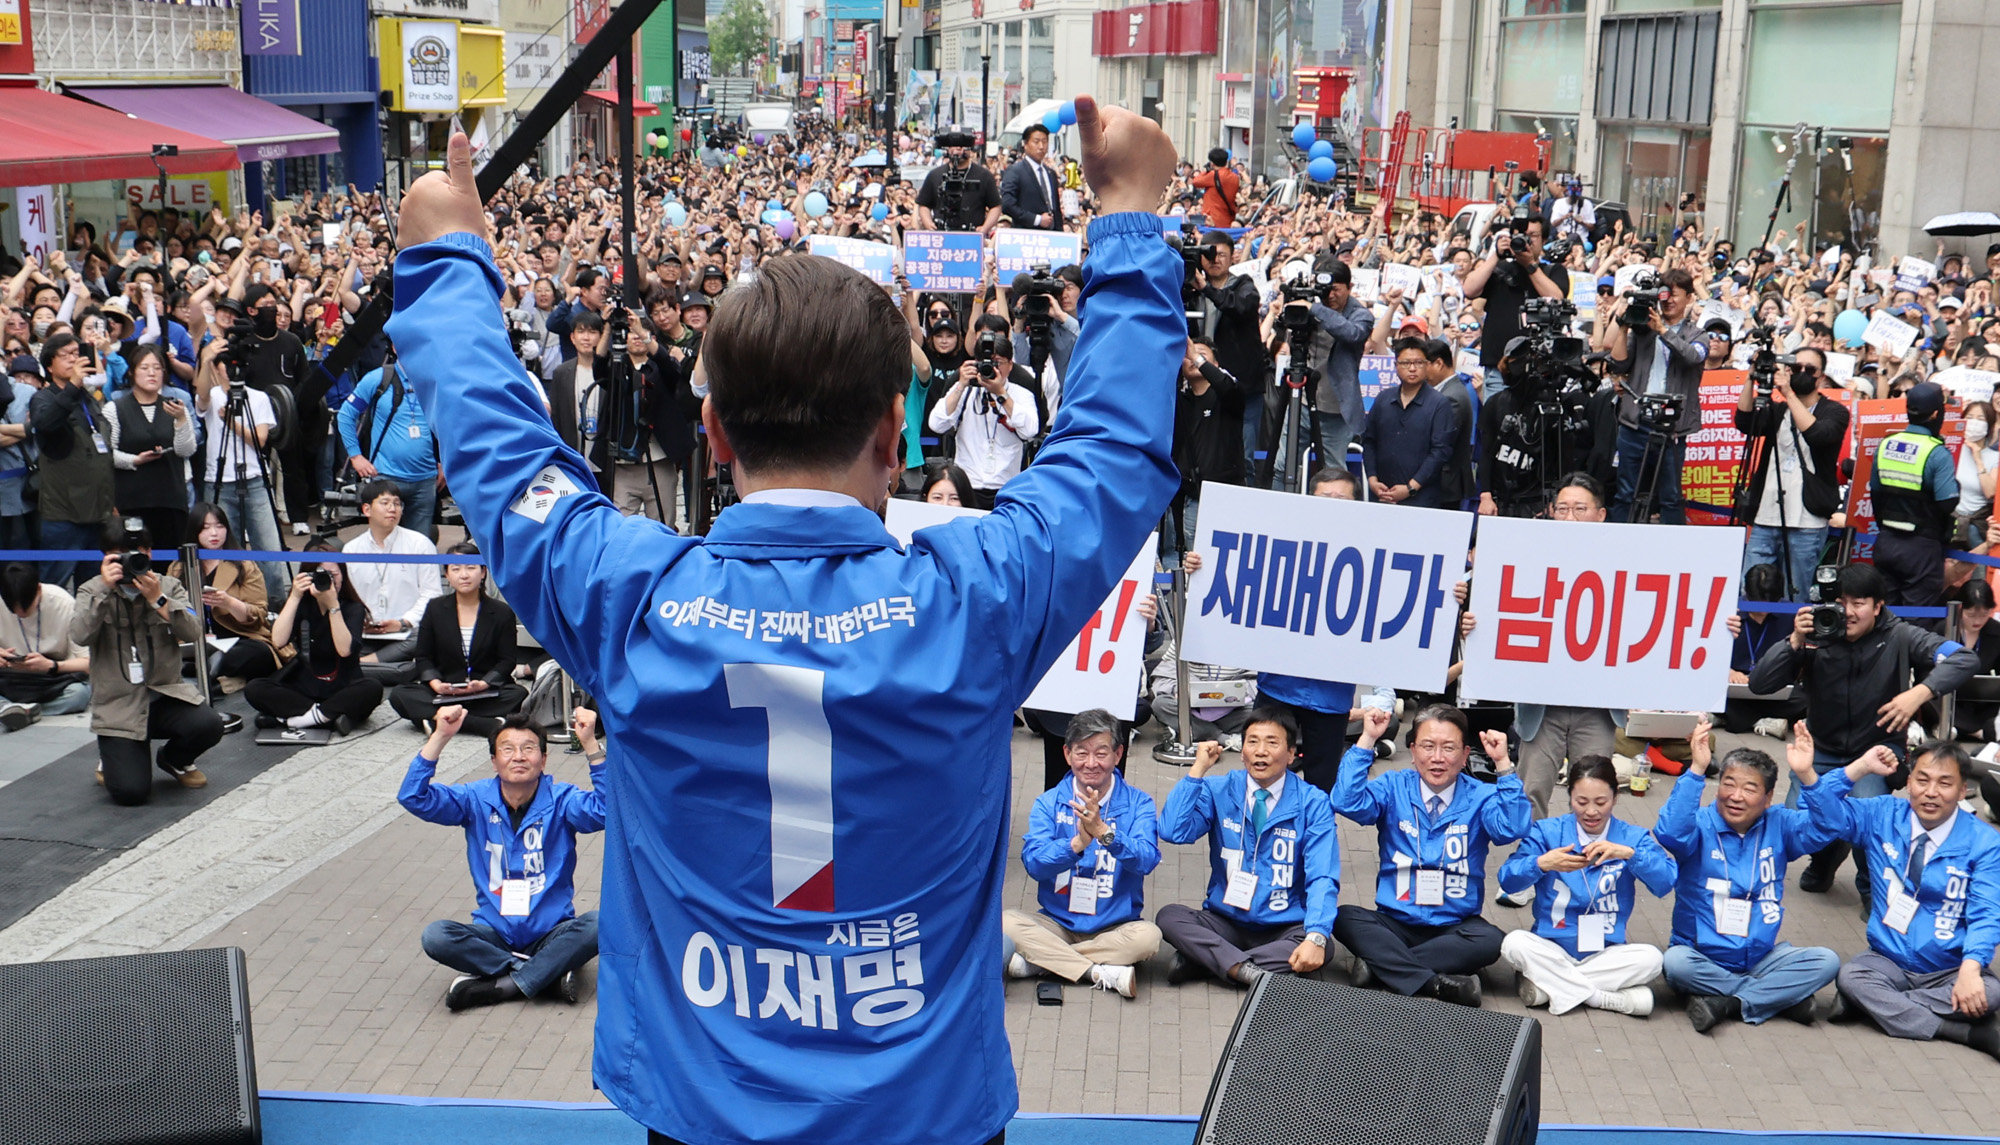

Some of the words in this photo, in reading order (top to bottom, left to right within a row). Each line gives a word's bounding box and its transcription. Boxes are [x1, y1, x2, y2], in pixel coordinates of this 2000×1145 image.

[408, 91, 431, 101] Prize
[432, 91, 454, 102] Shop
[127, 184, 208, 207] SALE
[906, 234, 945, 248] 반월당
[926, 248, 979, 262] 지하상가
[905, 260, 944, 275] 공정한
[923, 275, 976, 290] 기회박탈
[1884, 451, 1913, 462] POLICE
[1201, 529, 1446, 650] 재매이가
[659, 595, 756, 640] 이제부터
[760, 610, 812, 644] 진짜
[814, 596, 917, 644] 대한민국
[1494, 563, 1728, 670] 남이가!
[723, 663, 835, 913] 1
[1273, 827, 1298, 840] 지금은
[1268, 837, 1296, 912] 이재명
[1391, 850, 1414, 902] 1
[1445, 834, 1470, 900] 이재명
[1550, 878, 1572, 929] 1
[1933, 875, 1969, 940] 이재명
[825, 911, 920, 948] 지금은
[681, 930, 926, 1031] 이재명
